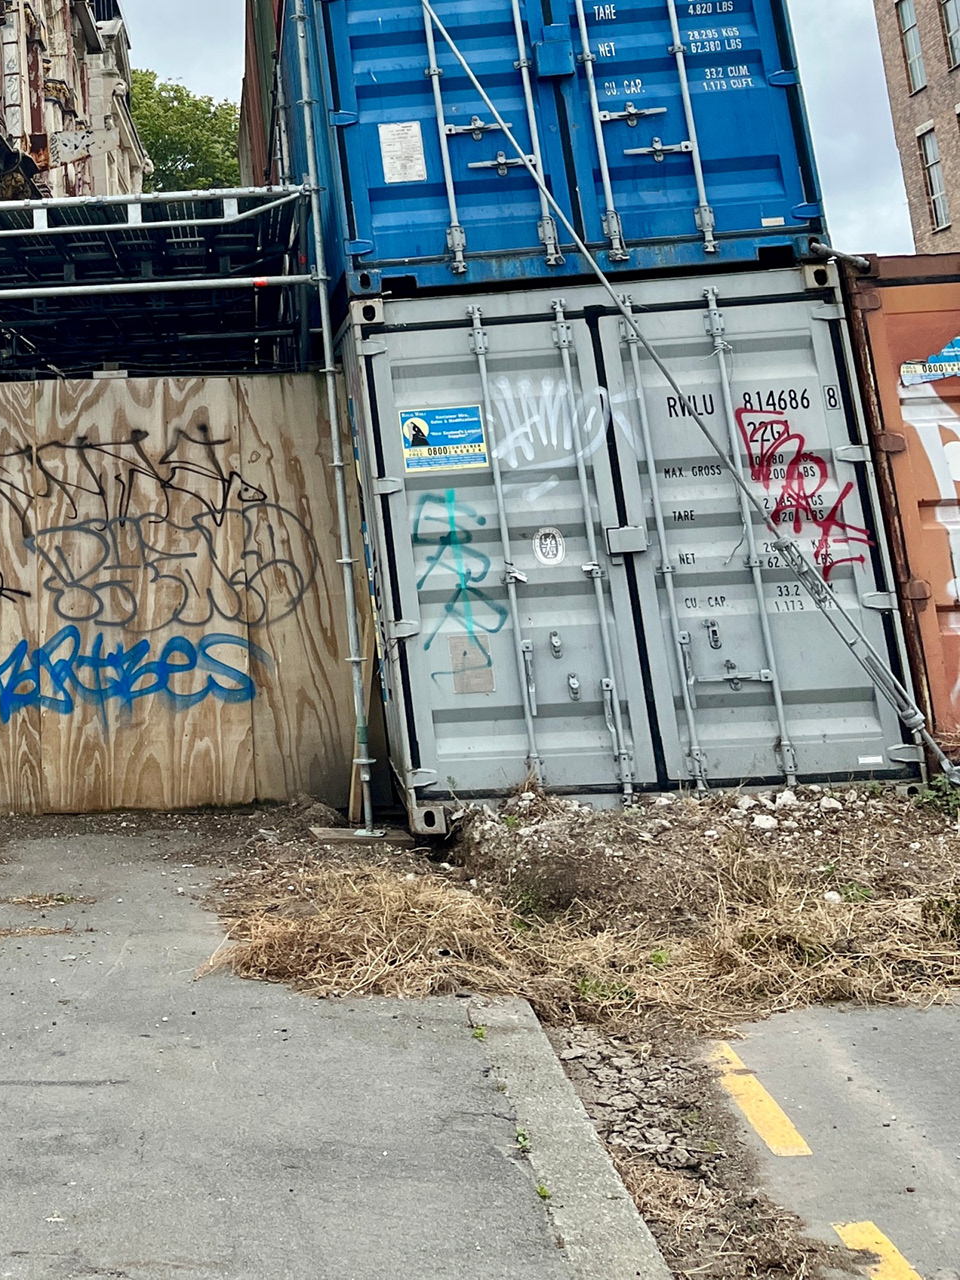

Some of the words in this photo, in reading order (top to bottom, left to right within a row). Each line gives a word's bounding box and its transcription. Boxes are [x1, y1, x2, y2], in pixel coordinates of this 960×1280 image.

[593, 4, 616, 21] TARE
[688, 3, 712, 15] 4.820
[716, 1, 734, 12] LBS
[688, 29, 718, 41] 28.295
[721, 27, 739, 38] KGS
[598, 42, 615, 57] NET
[691, 41, 721, 54] 62.380
[725, 39, 742, 50] LBS
[705, 67, 724, 80] 33.2
[604, 81, 620, 96] CU.
[624, 79, 646, 95] CAP.
[703, 81, 727, 92] 1.173
[921, 364, 944, 373] 0800
[666, 394, 715, 418] RWLU
[742, 388, 810, 412] 814686
[825, 386, 839, 410] 8
[746, 420, 790, 443] 22G1
[427, 447, 448, 456] 0800
[664, 467, 688, 479] MAX.
[691, 465, 722, 477] GROSS
[672, 510, 695, 521] TARE
[679, 553, 696, 565] NET
[777, 585, 800, 597] 33.2
[685, 597, 701, 609] CU.
[707, 596, 729, 608] CAP.
[775, 600, 804, 612] 1.173
